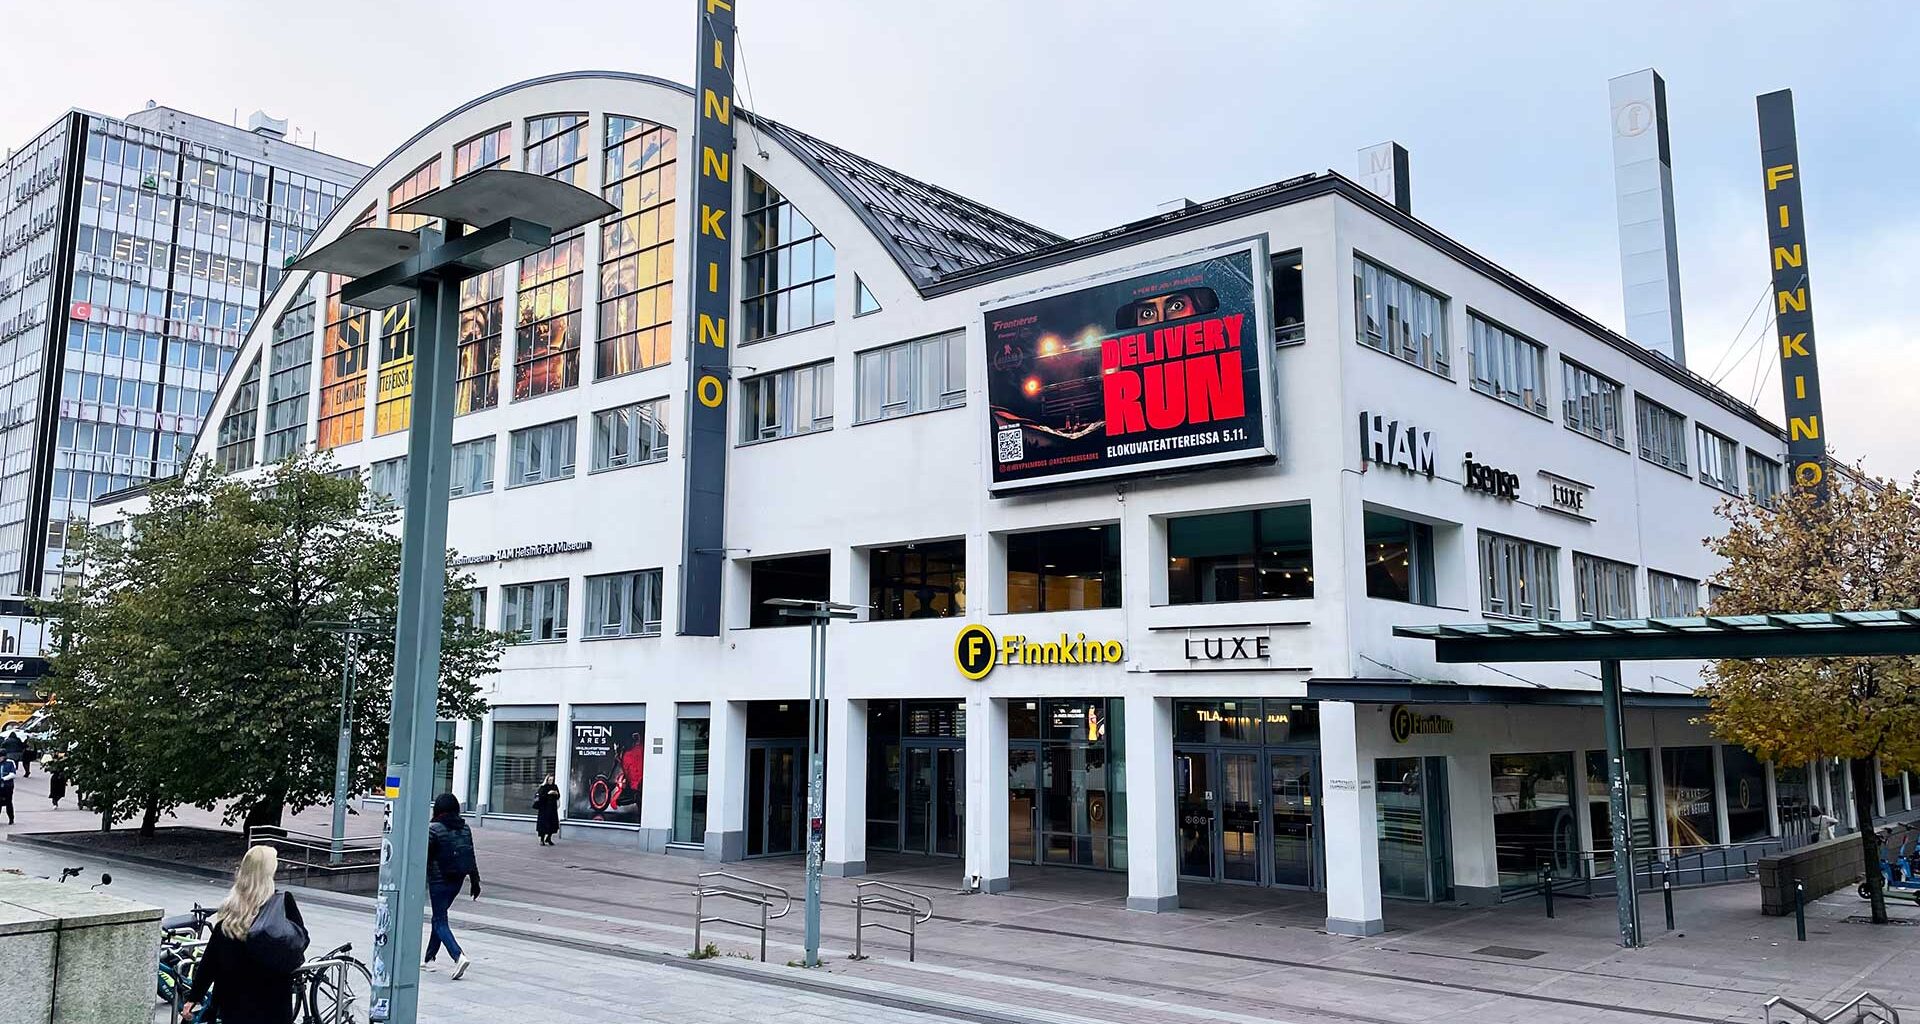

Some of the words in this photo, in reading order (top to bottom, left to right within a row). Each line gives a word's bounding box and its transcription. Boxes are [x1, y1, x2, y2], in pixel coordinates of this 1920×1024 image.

[1767, 163, 1823, 488] FINNKINO
[1101, 313, 1244, 370] DELIVERY
[1104, 351, 1246, 437] RUN
[1107, 431, 1220, 458] ELOKUVATEATTEREISSA
[1223, 428, 1248, 442] 5.11.
[1360, 411, 1439, 477] HAM
[1463, 451, 1520, 500] isense
[1552, 483, 1584, 509] LUXE
[496, 549, 514, 561] HAM
[514, 546, 543, 558] Helsinki
[543, 544, 555, 556] Art
[556, 540, 592, 553] Museum
[1001, 632, 1123, 666] Finnkino
[1184, 636, 1270, 660] LUXE
[575, 725, 613, 737] TRON
[1412, 712, 1454, 735] Finnkino
[580, 737, 607, 745] ARES
